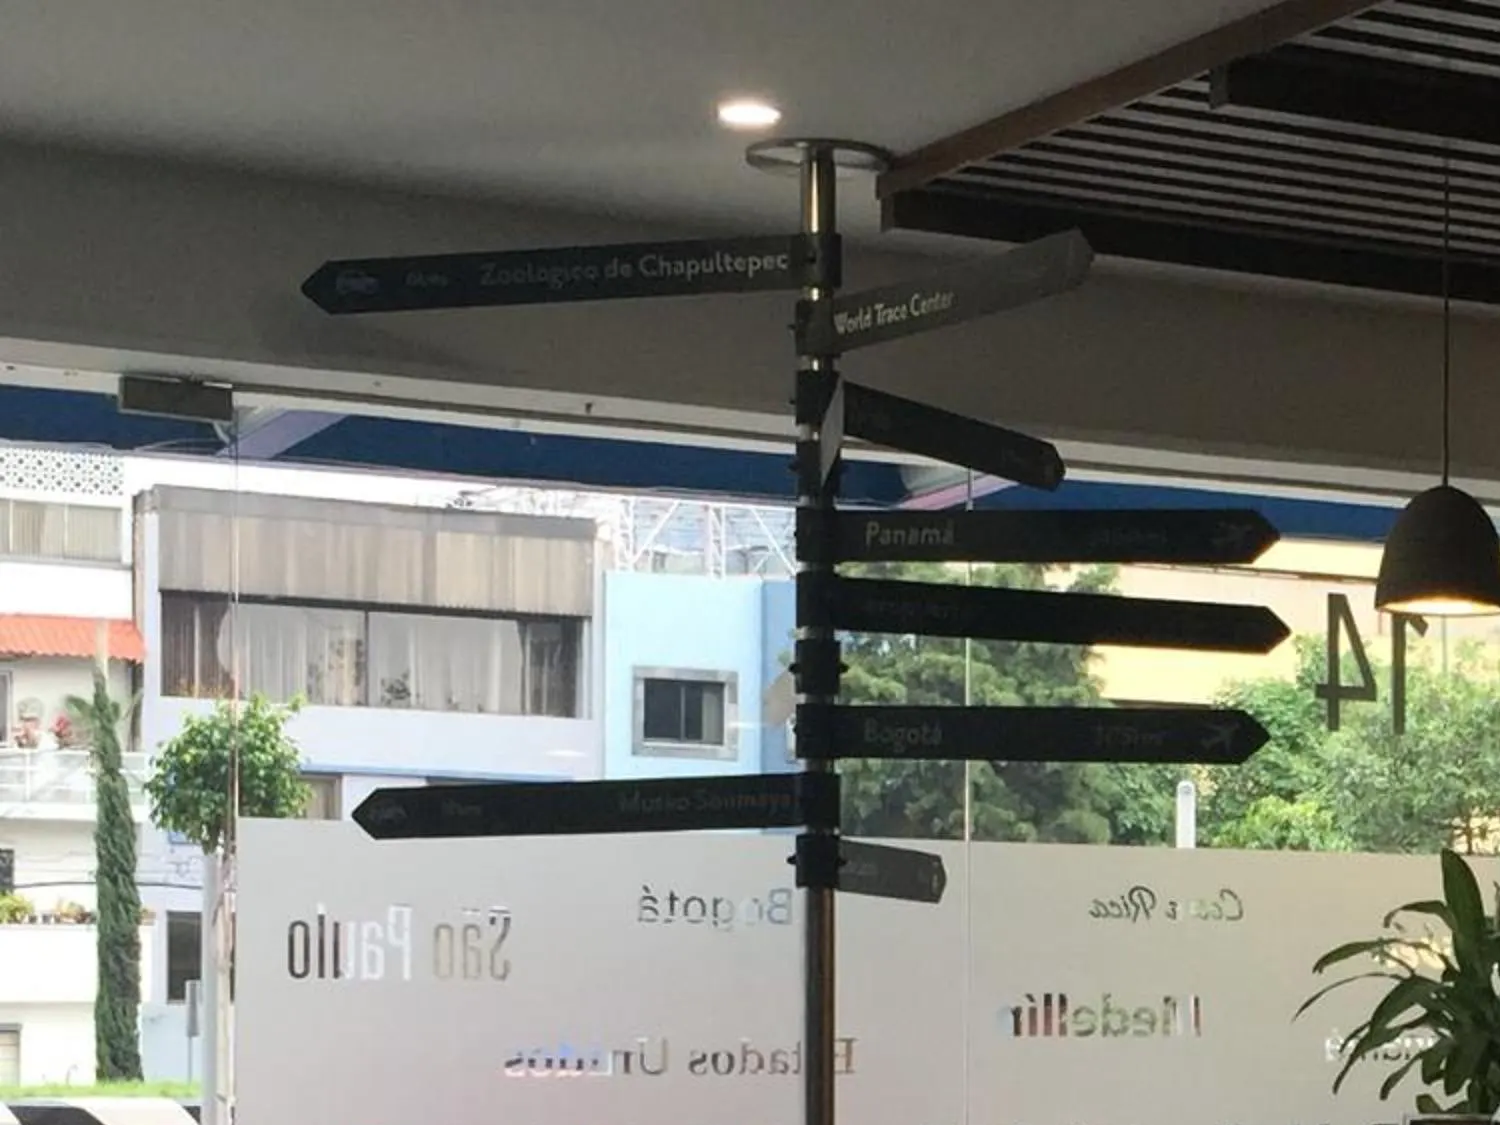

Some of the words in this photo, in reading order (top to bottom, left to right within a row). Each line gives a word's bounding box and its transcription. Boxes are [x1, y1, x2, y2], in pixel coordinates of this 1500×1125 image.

[603, 259, 633, 279] de
[638, 251, 789, 281] Chapultepec
[833, 304, 873, 335] World
[910, 291, 957, 317] Center
[863, 519, 955, 548] Panamá
[863, 718, 944, 753] Bogotá
